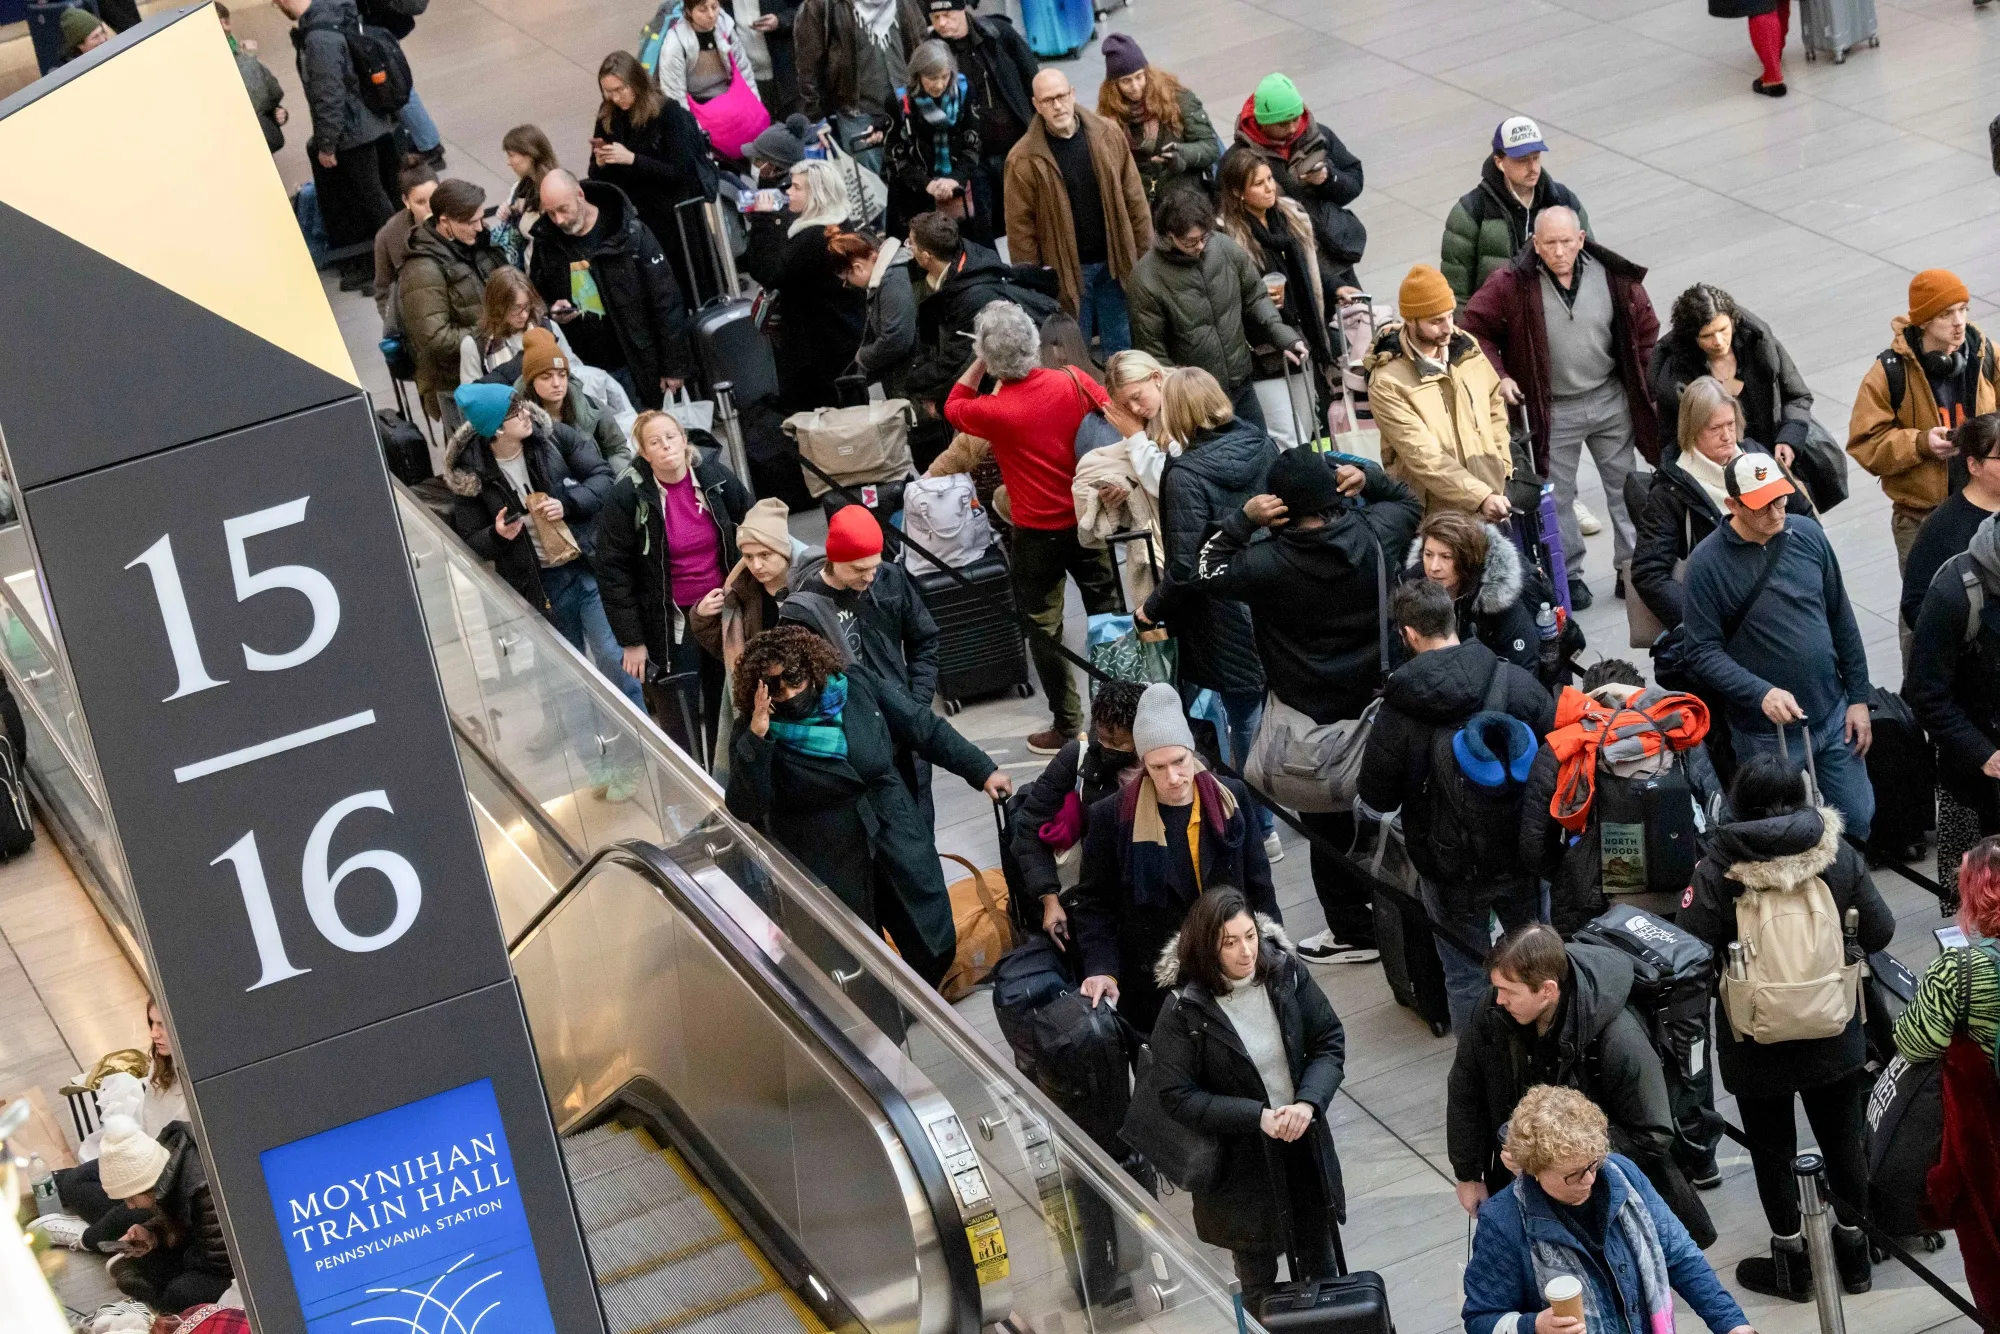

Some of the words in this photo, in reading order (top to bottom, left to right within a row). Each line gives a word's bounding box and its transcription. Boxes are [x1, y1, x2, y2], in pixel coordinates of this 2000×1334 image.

[124, 495, 341, 703] 15
[210, 789, 422, 992] 16
[1603, 847, 1639, 855] WOODS
[288, 1132, 497, 1225] MOYNIHAN
[292, 1195, 407, 1253] TRAIN
[416, 1162, 511, 1213] HALL
[967, 1211, 994, 1226] CAUTION
[315, 1223, 432, 1273] PENNSYLVANIA
[435, 1198, 503, 1231] STATION
